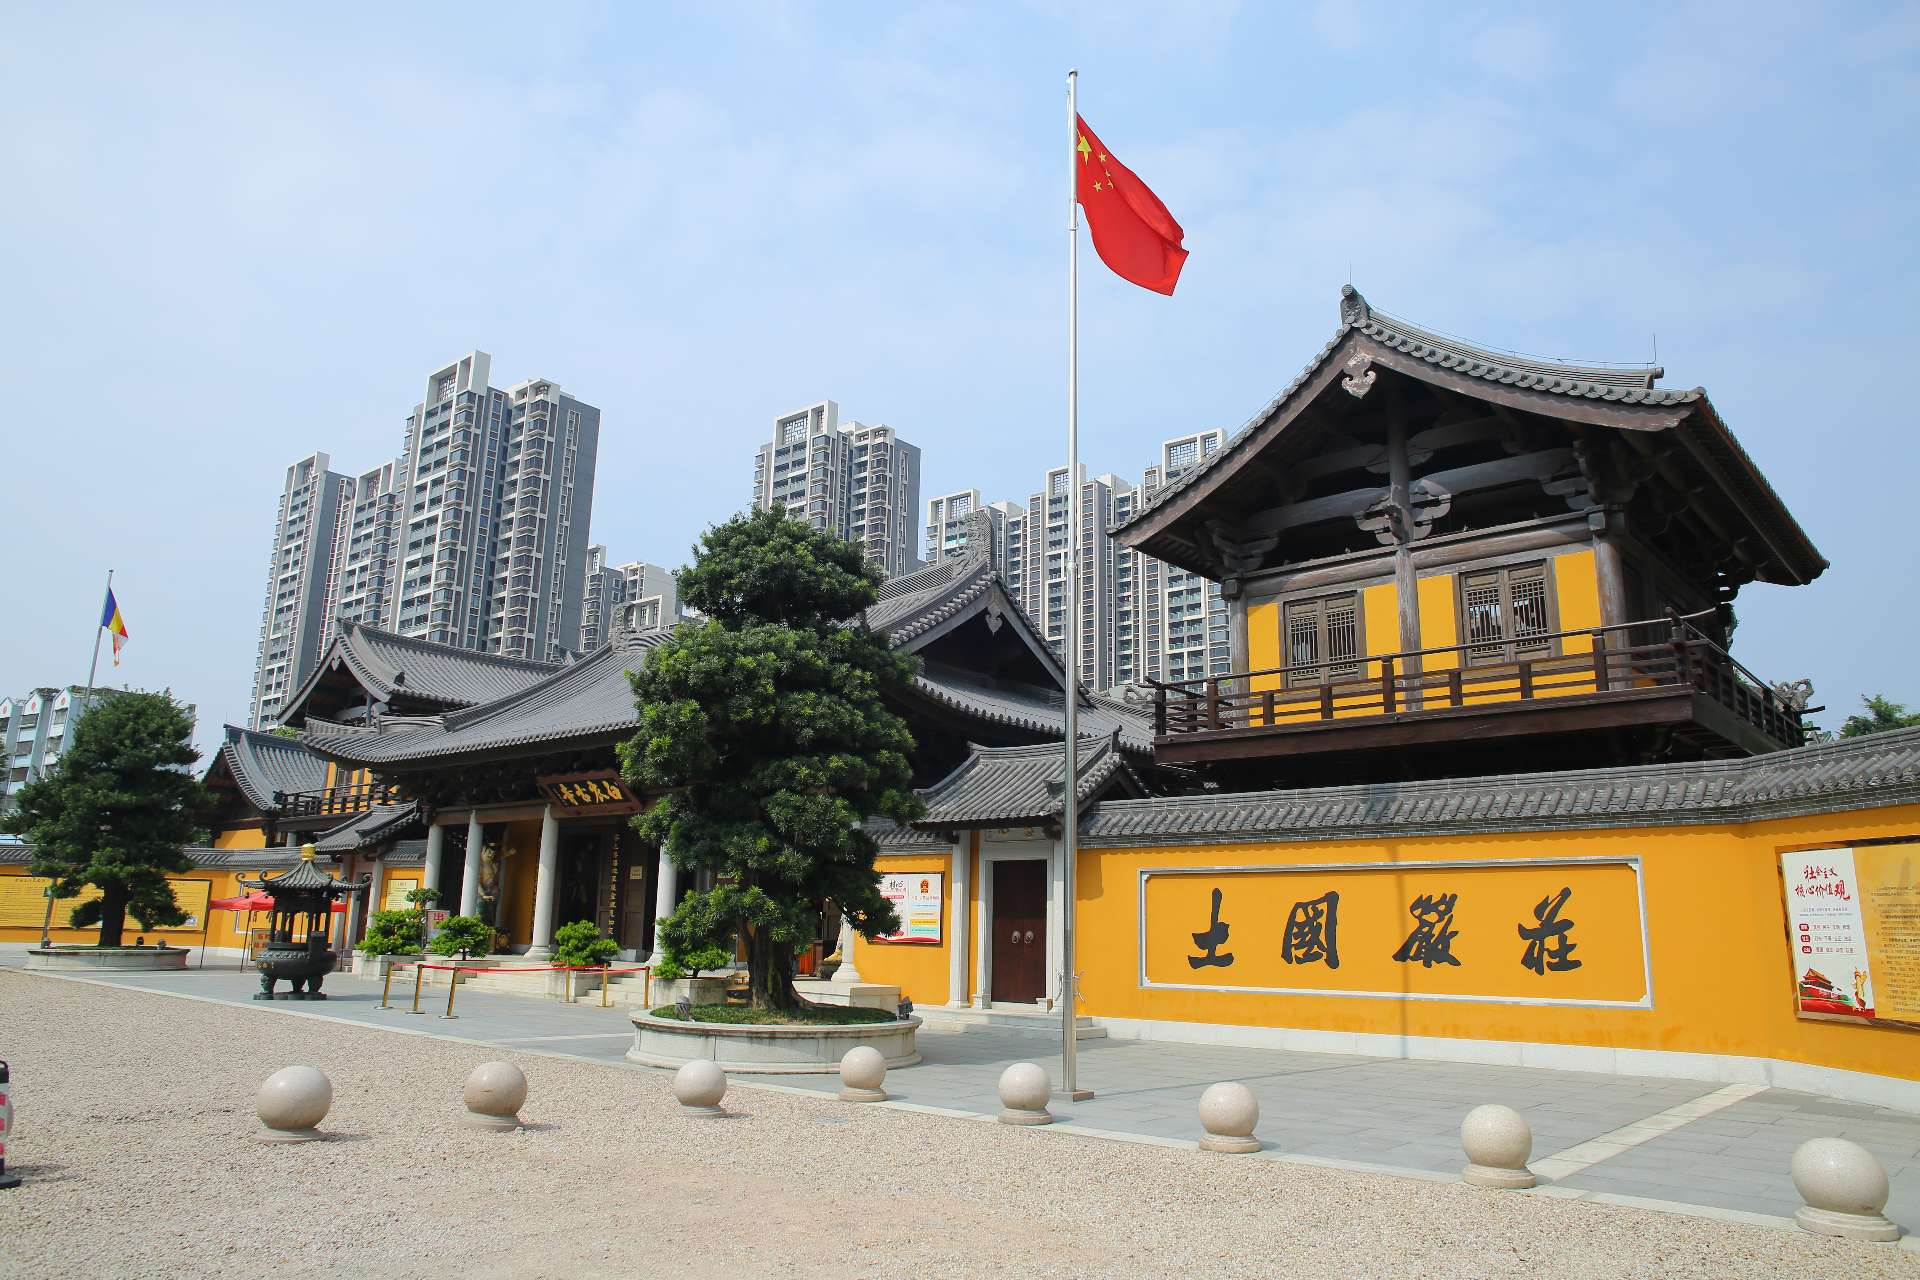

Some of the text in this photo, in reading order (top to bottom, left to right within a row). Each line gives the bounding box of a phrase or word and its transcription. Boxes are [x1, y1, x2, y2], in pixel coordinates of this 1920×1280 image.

[1795, 880, 1851, 901] 核心价值观
